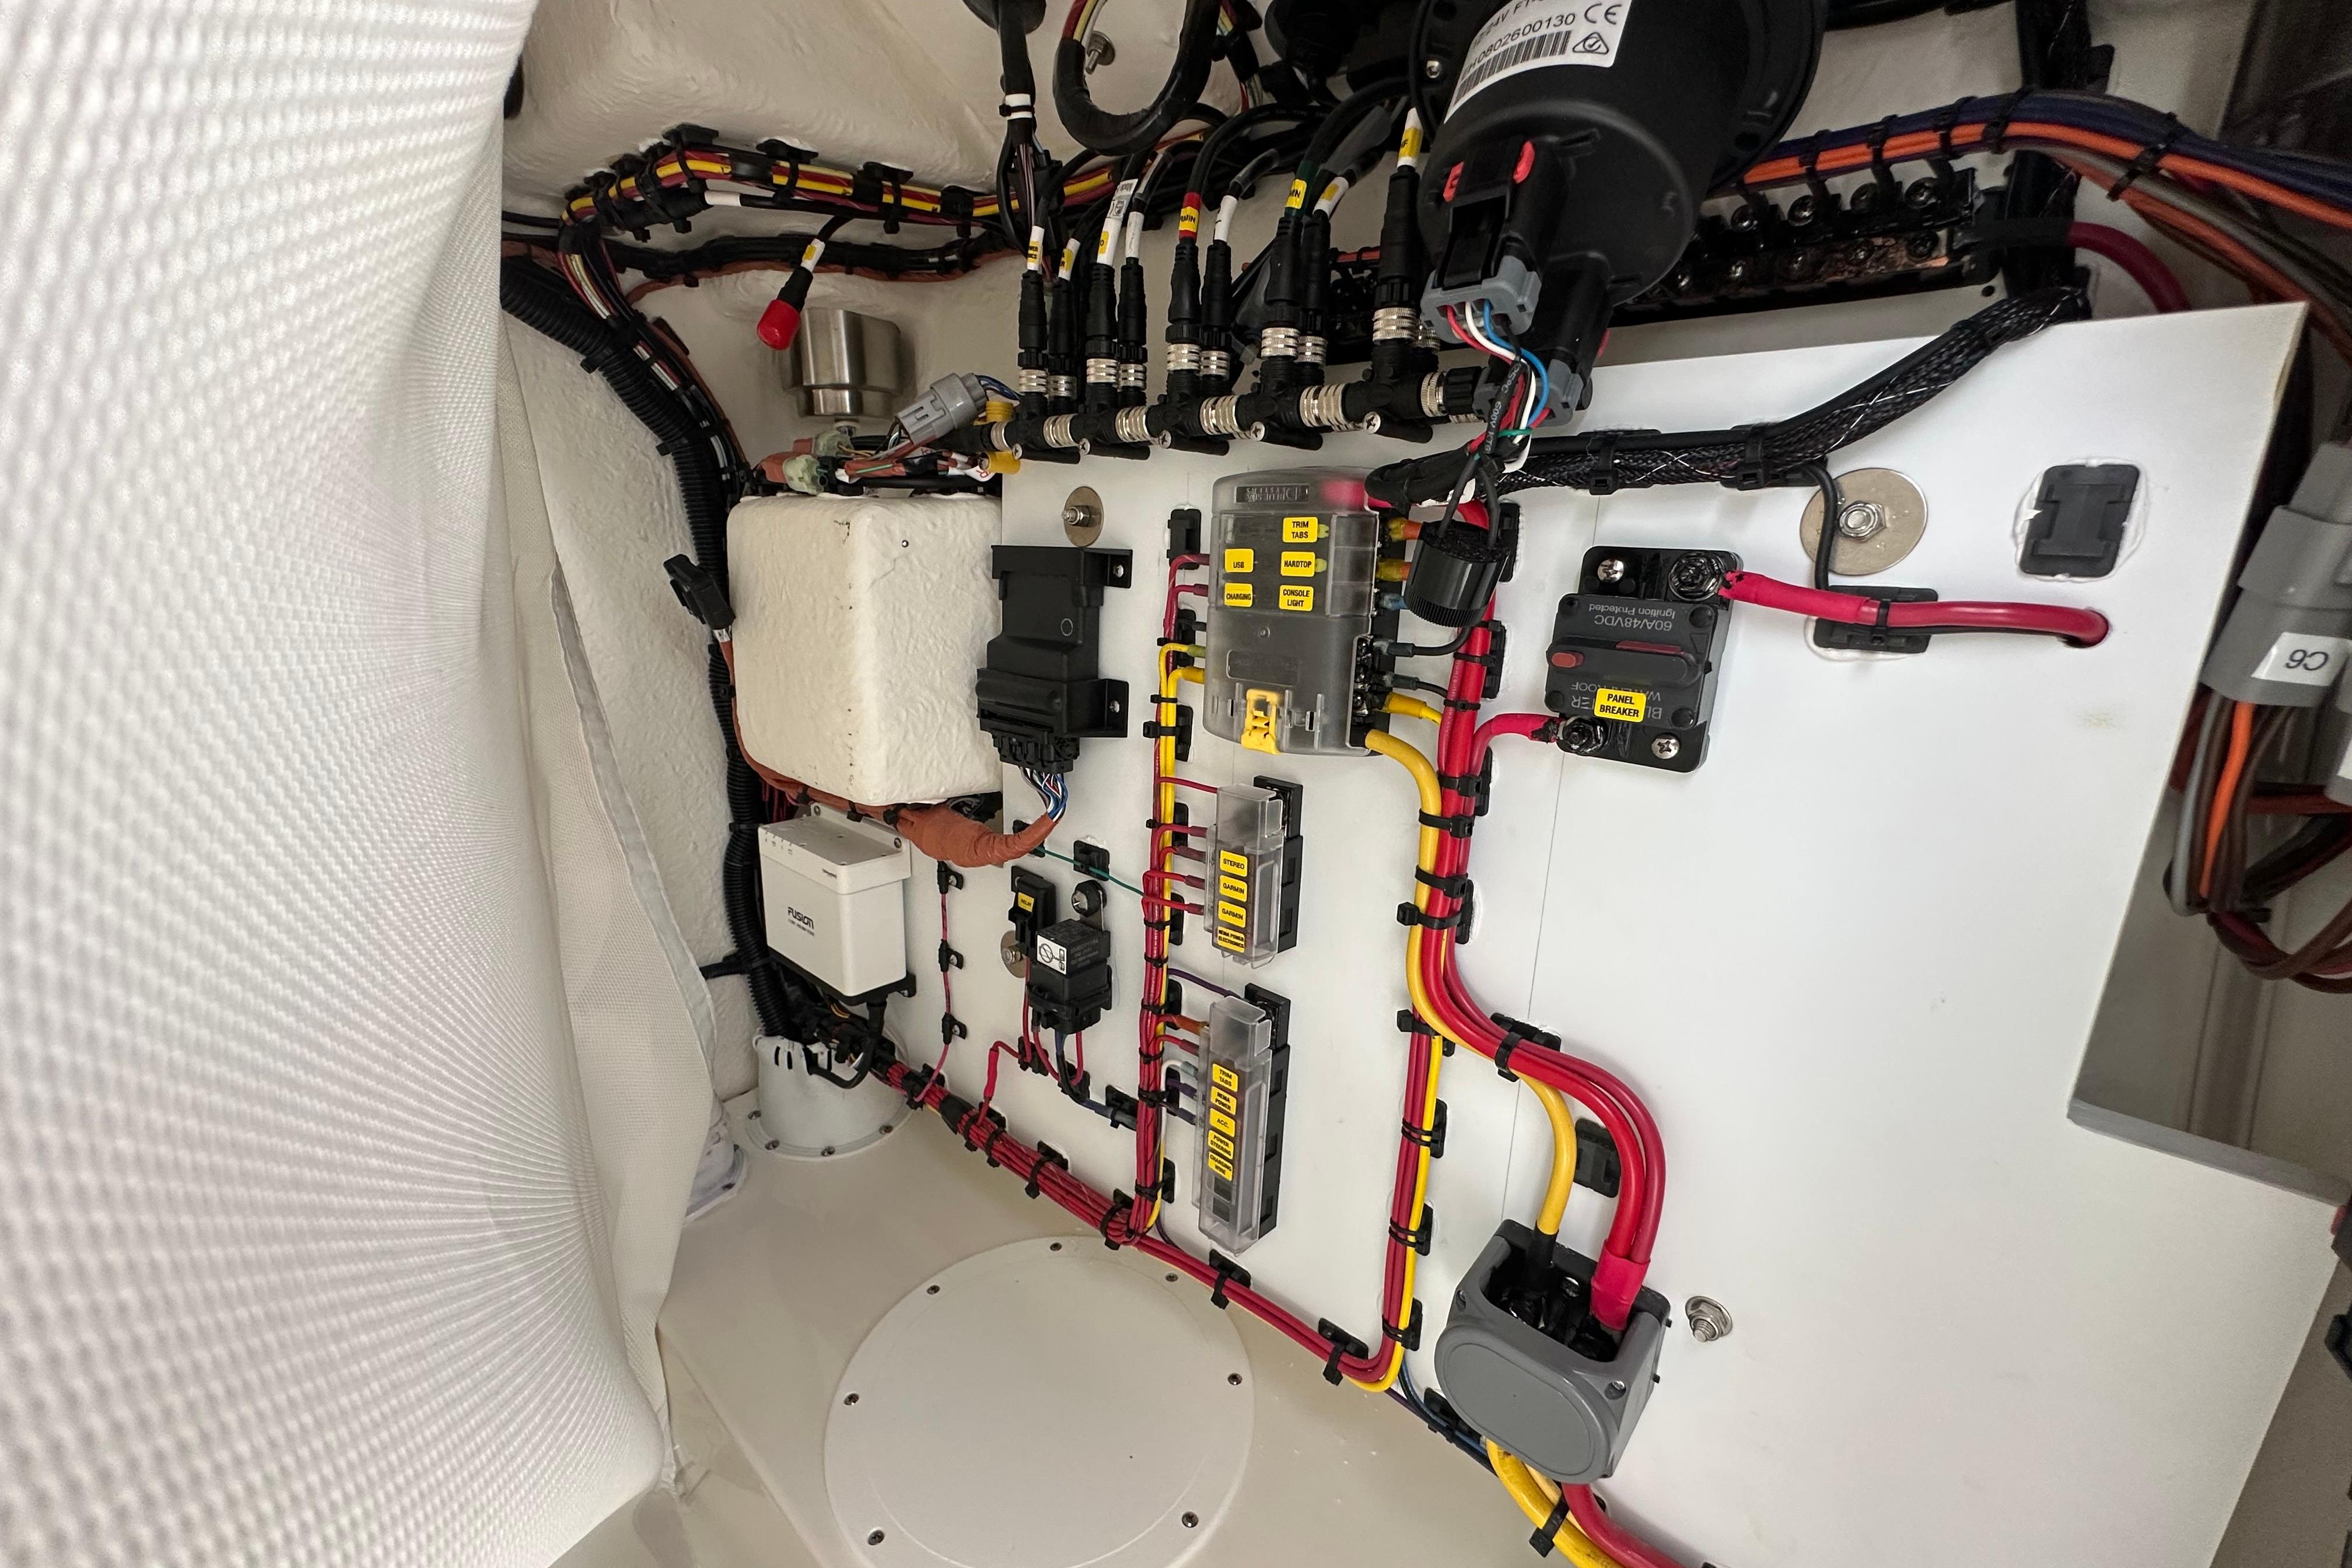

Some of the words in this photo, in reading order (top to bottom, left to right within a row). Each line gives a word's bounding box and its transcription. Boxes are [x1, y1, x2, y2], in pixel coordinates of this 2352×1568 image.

[1584, 3, 1622, 24] CE
[1284, 560, 1312, 568] HARDTOP
[1283, 589, 1310, 597] CONSOLE
[1287, 599, 1304, 607] LIGHT
[1589, 603, 1636, 615] Protected
[1638, 605, 1675, 619] Ignition
[1594, 615, 1672, 631] 60A/48VDC
[2285, 649, 2329, 671] C6
[1606, 693, 1635, 705] PANEL
[1599, 704, 1640, 718] BREAKER
[1223, 858, 1245, 870] STEREO
[1223, 882, 1245, 894] GARMIN
[788, 906, 814, 929] FUSION
[1222, 908, 1244, 921] GARMIN
[1219, 1069, 1232, 1080] TRIM
[1219, 1076, 1232, 1087] TABS
[1215, 1098, 1231, 1111] POWER
[1213, 1134, 1230, 1148] POWER
[1210, 1139, 1231, 1157] STEERING
[1210, 1154, 1232, 1172] CHARGING
[1214, 1164, 1226, 1175] WIRE
